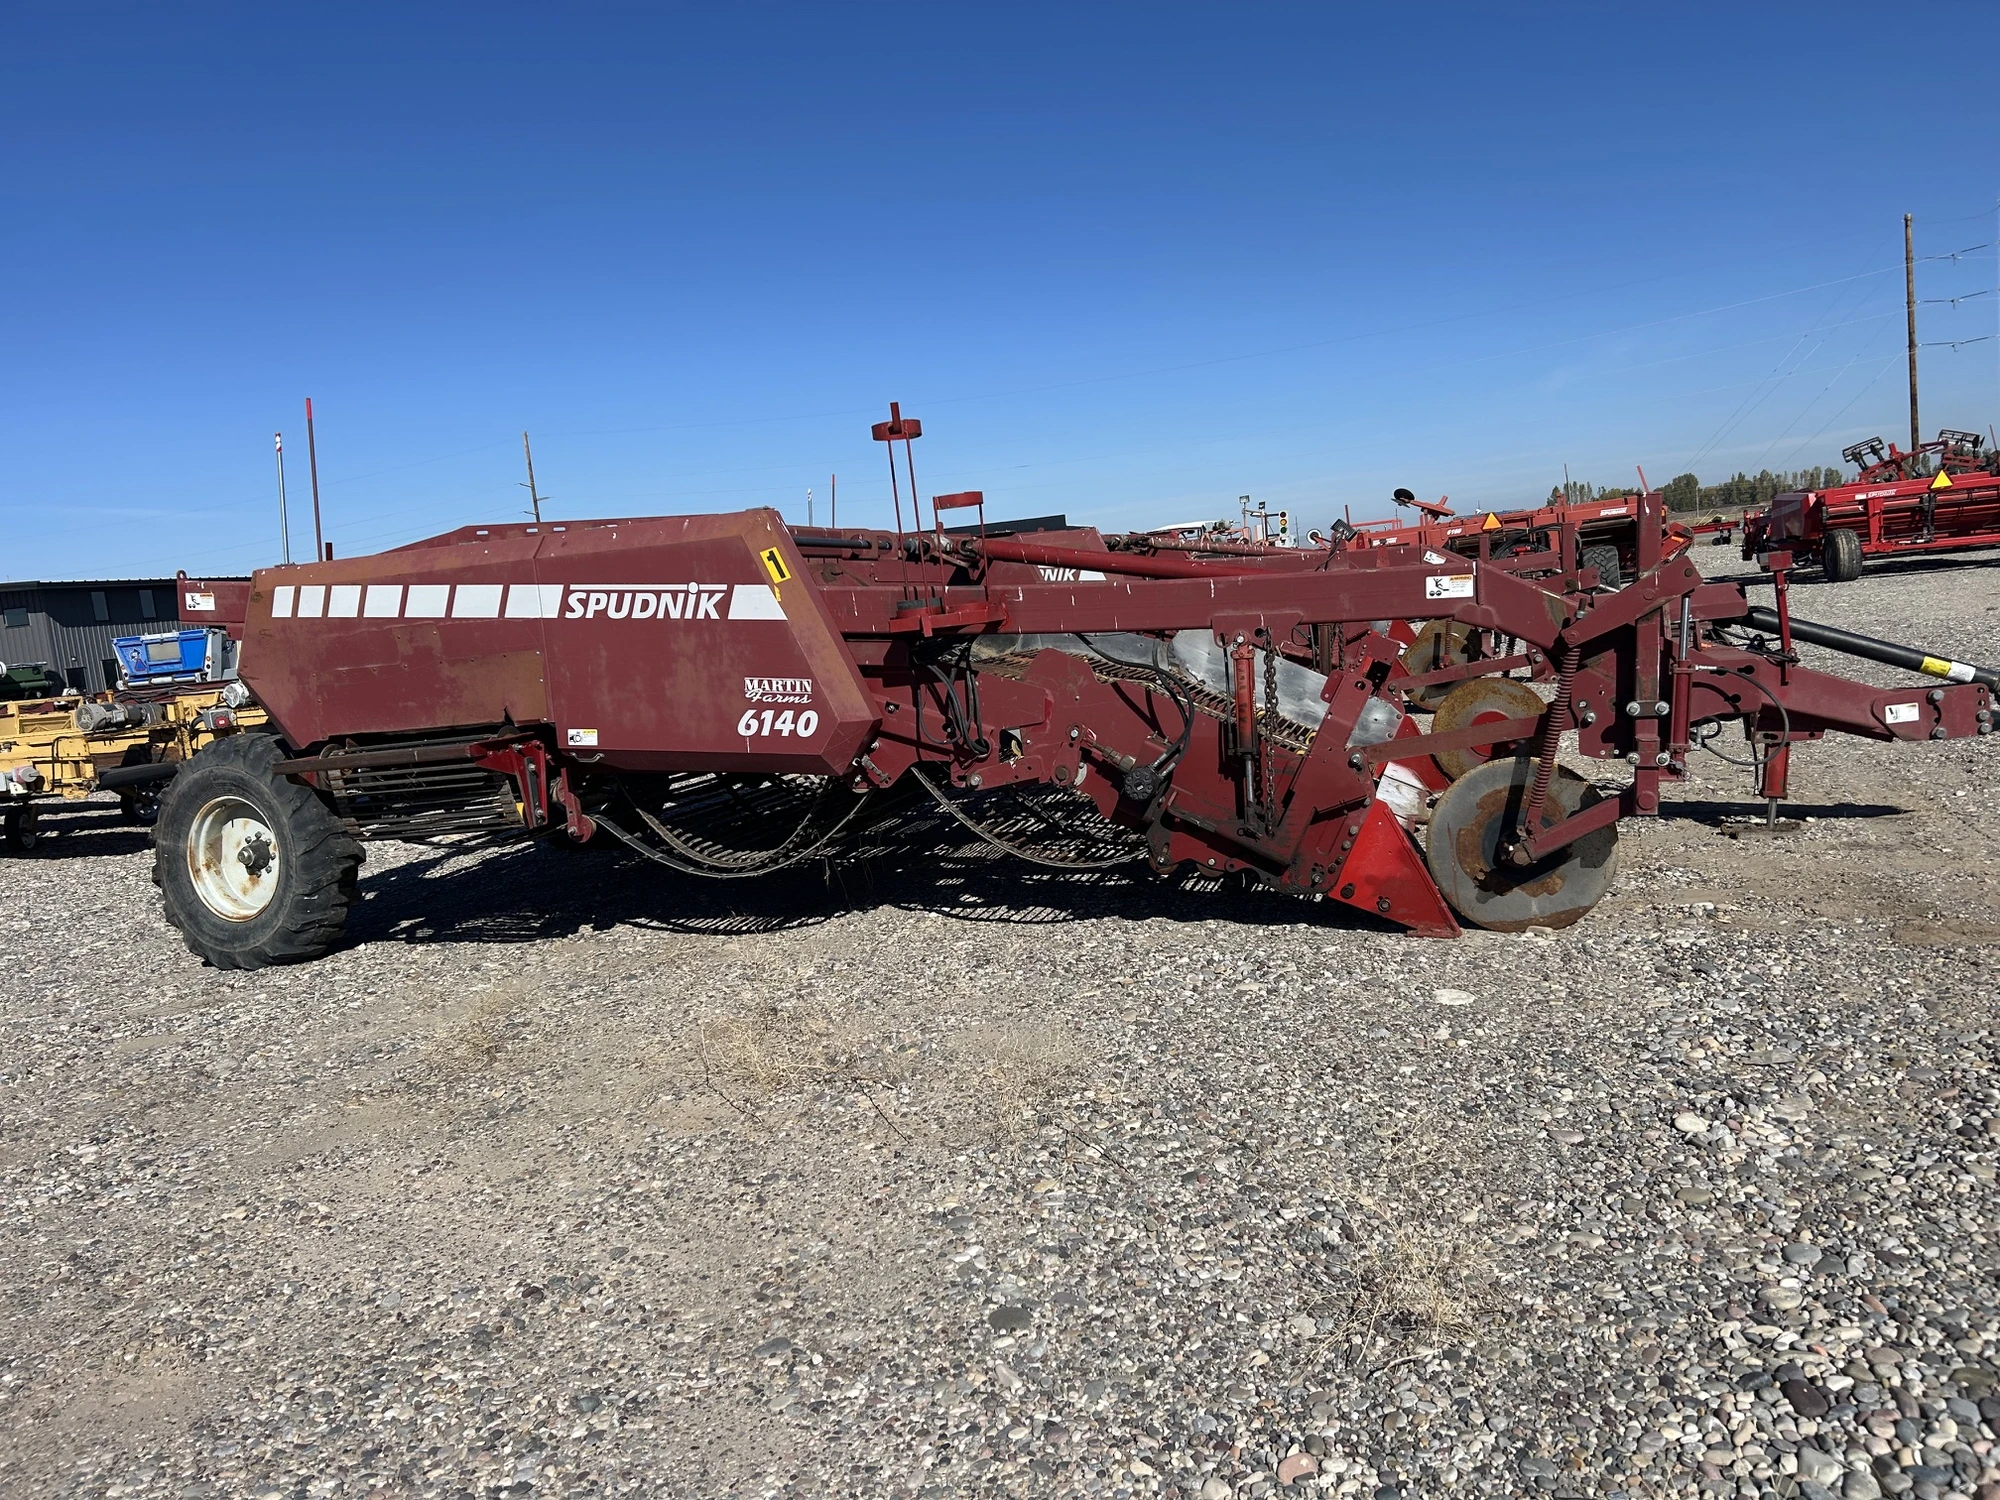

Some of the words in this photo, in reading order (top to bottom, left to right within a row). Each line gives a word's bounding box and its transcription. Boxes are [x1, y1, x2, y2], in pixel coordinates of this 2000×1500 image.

[766, 550, 787, 580] 1
[564, 582, 726, 620] SPUDNIK
[744, 677, 812, 694] MARTIN
[745, 688, 812, 704] Farms
[737, 709, 819, 738] 6140
